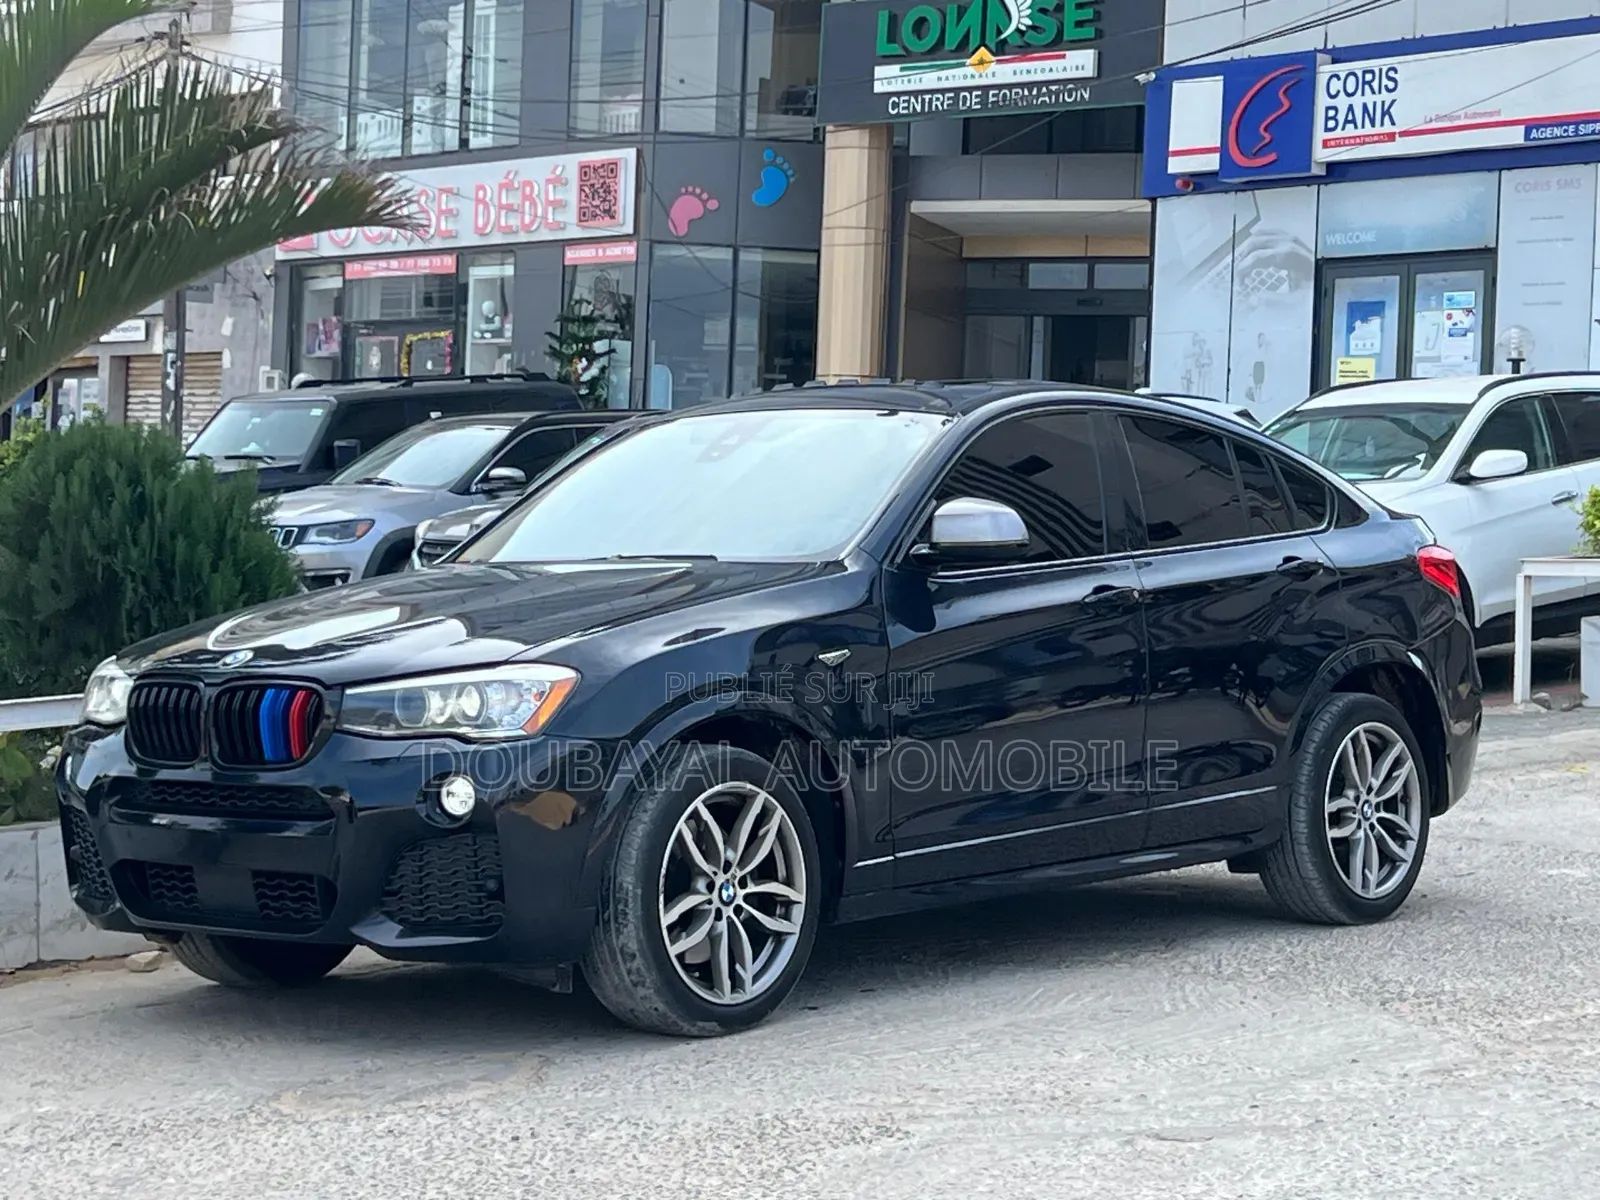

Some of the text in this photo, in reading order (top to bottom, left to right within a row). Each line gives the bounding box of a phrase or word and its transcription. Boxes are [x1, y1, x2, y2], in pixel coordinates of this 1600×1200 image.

[936, 71, 998, 83] NATIONALE
[1326, 66, 1399, 100] CORIS
[887, 85, 1091, 115] CENTRE DE FORMATION
[1323, 99, 1397, 133] BANK
[1530, 125, 1577, 140] AGENCE
[1514, 181, 1553, 194] CORIS
[473, 163, 568, 236] BÉBÉ
[1326, 230, 1377, 246] WELCOME
